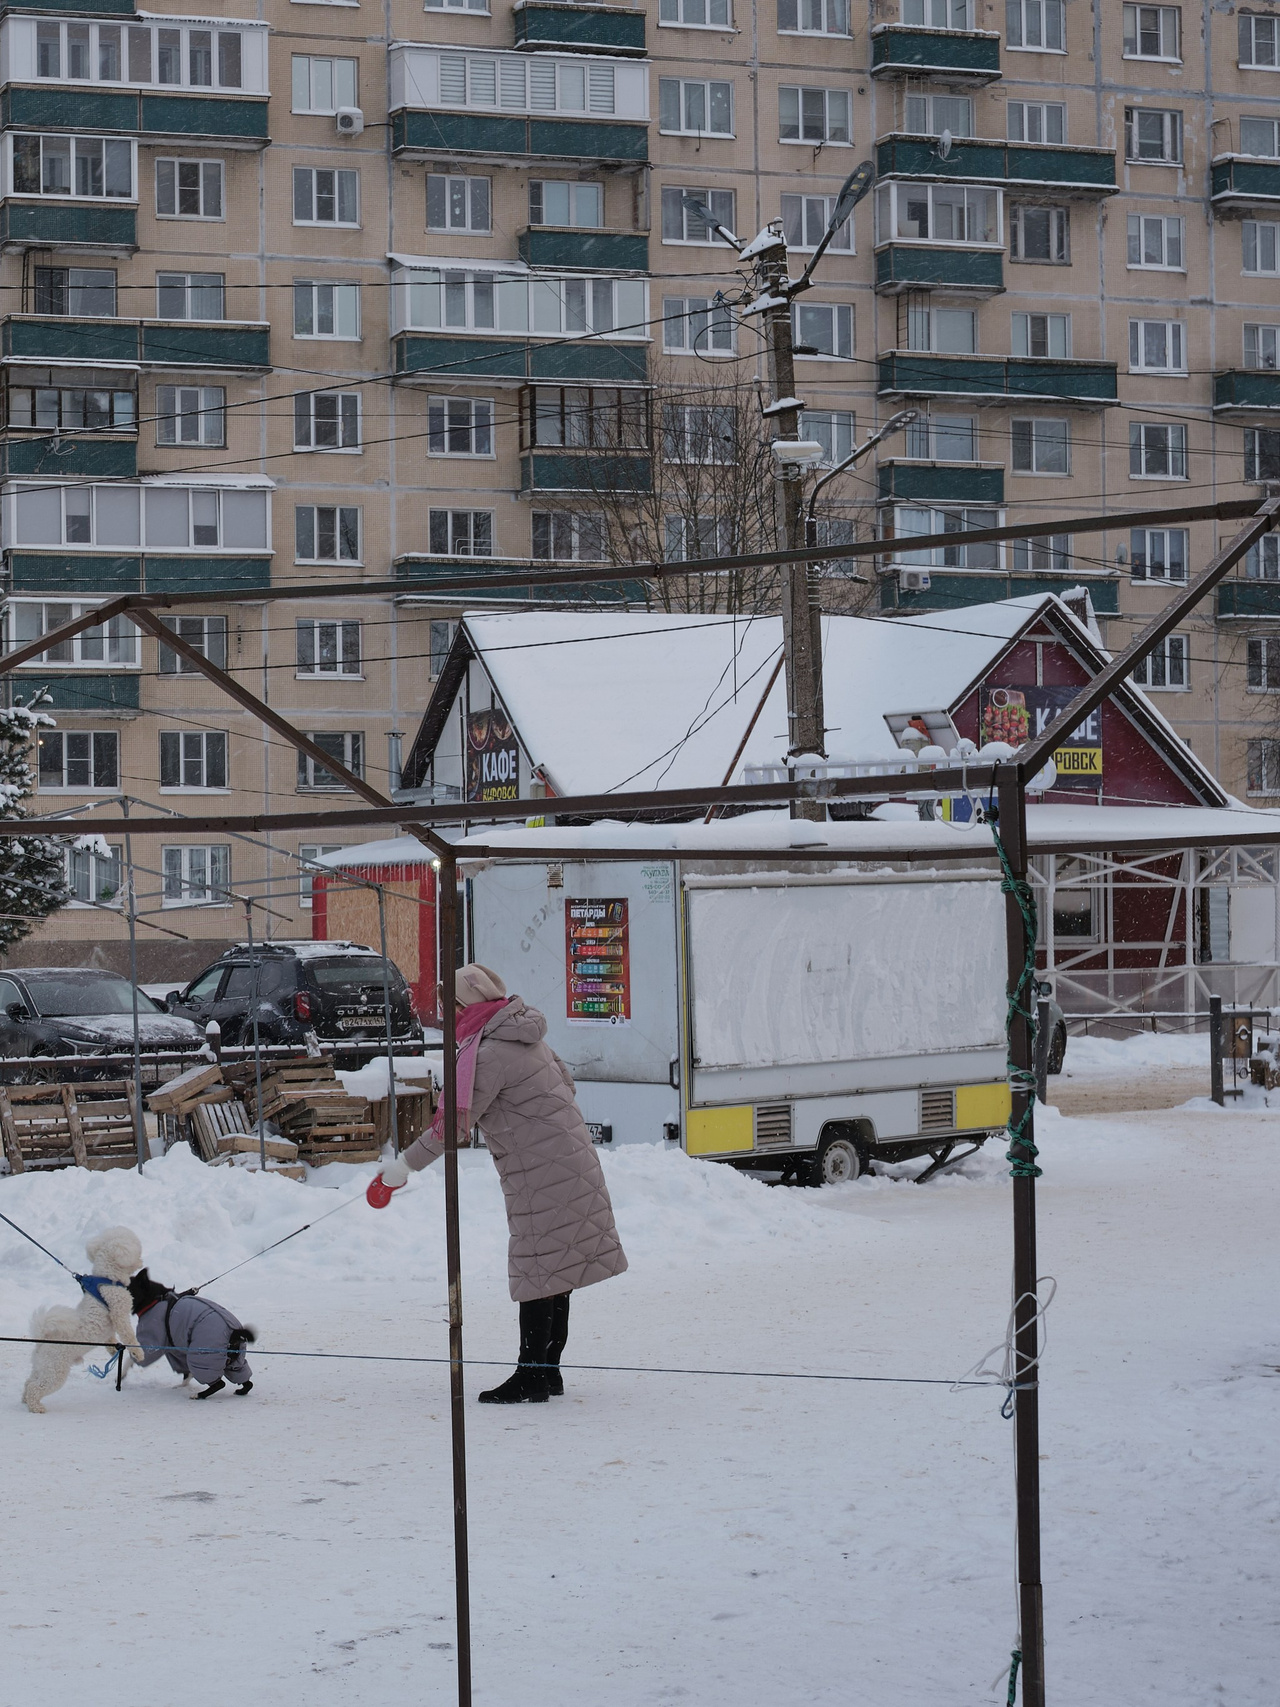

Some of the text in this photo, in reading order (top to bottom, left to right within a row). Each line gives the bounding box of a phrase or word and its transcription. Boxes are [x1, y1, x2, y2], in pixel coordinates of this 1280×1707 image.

[482, 748, 517, 783] КАФЕ
[1054, 751, 1098, 771] РОВСК
[570, 908, 606, 920] ПЕТАРДЫ
[589, 1125, 599, 1136] 47
